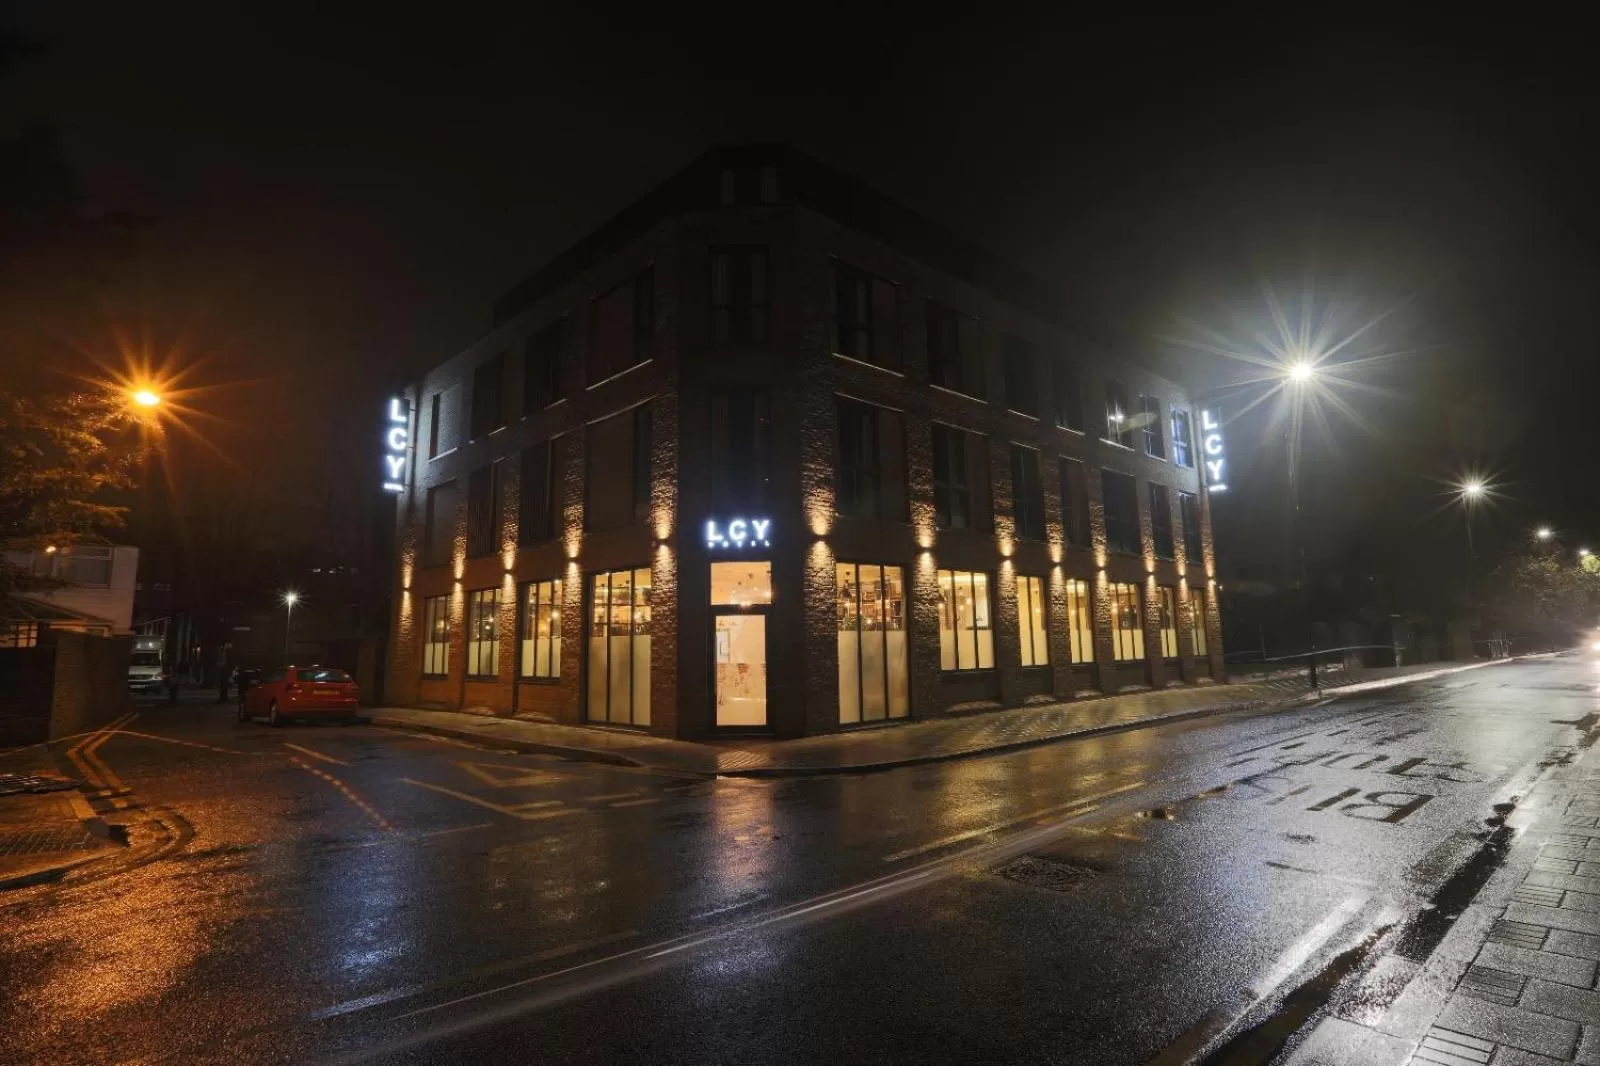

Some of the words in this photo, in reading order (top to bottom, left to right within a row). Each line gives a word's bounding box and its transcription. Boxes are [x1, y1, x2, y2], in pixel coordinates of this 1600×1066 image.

[386, 398, 408, 479] LCY
[1202, 410, 1224, 480] LCY
[707, 519, 770, 540] LCY
